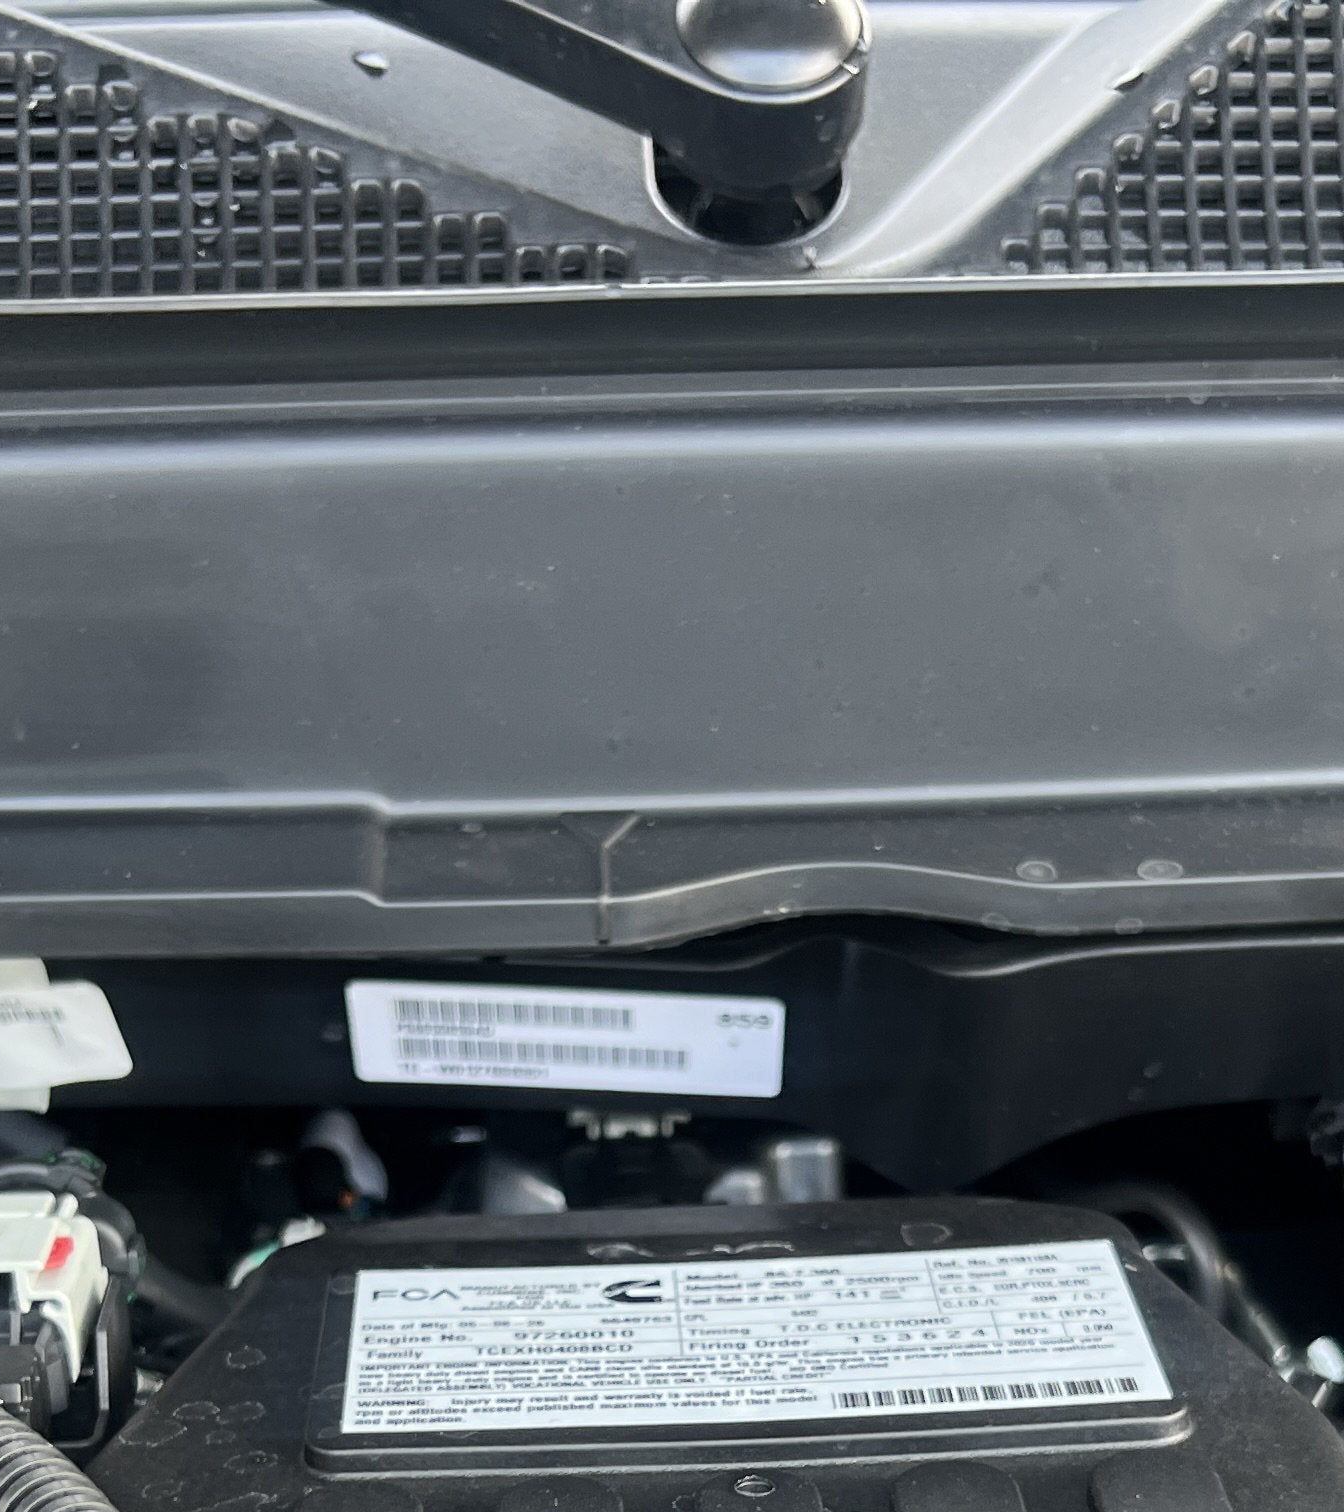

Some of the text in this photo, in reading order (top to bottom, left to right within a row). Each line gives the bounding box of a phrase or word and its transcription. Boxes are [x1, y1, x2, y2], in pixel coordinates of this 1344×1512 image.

[686, 1272, 737, 1280] Model
[372, 1287, 460, 1302] FCA
[362, 1323, 394, 1331] Date
[686, 1326, 752, 1338] Timing
[835, 1316, 952, 1330] ELECTRONIC
[363, 1332, 472, 1346] Engine No.
[687, 1339, 746, 1351] Firing
[754, 1338, 810, 1348] Order
[366, 1348, 423, 1361] Family
[360, 1361, 431, 1371] IMPORTANT
[450, 1396, 490, 1406] Injury
[495, 1396, 523, 1406] may
[529, 1393, 568, 1403] result
[573, 1393, 597, 1402] and
[603, 1391, 662, 1402] warranty
[684, 1389, 730, 1398] voided
[749, 1387, 775, 1396] fuel
[355, 1409, 383, 1418] rpm
[408, 1405, 467, 1416] altitudes
[472, 1404, 521, 1413] exceed
[526, 1401, 594, 1413] published
[599, 1400, 666, 1410] maximum
[671, 1398, 717, 1408] values
[721, 1397, 740, 1405] for
[745, 1396, 770, 1404] this
[775, 1394, 818, 1403] model
[353, 1417, 380, 1425] and
